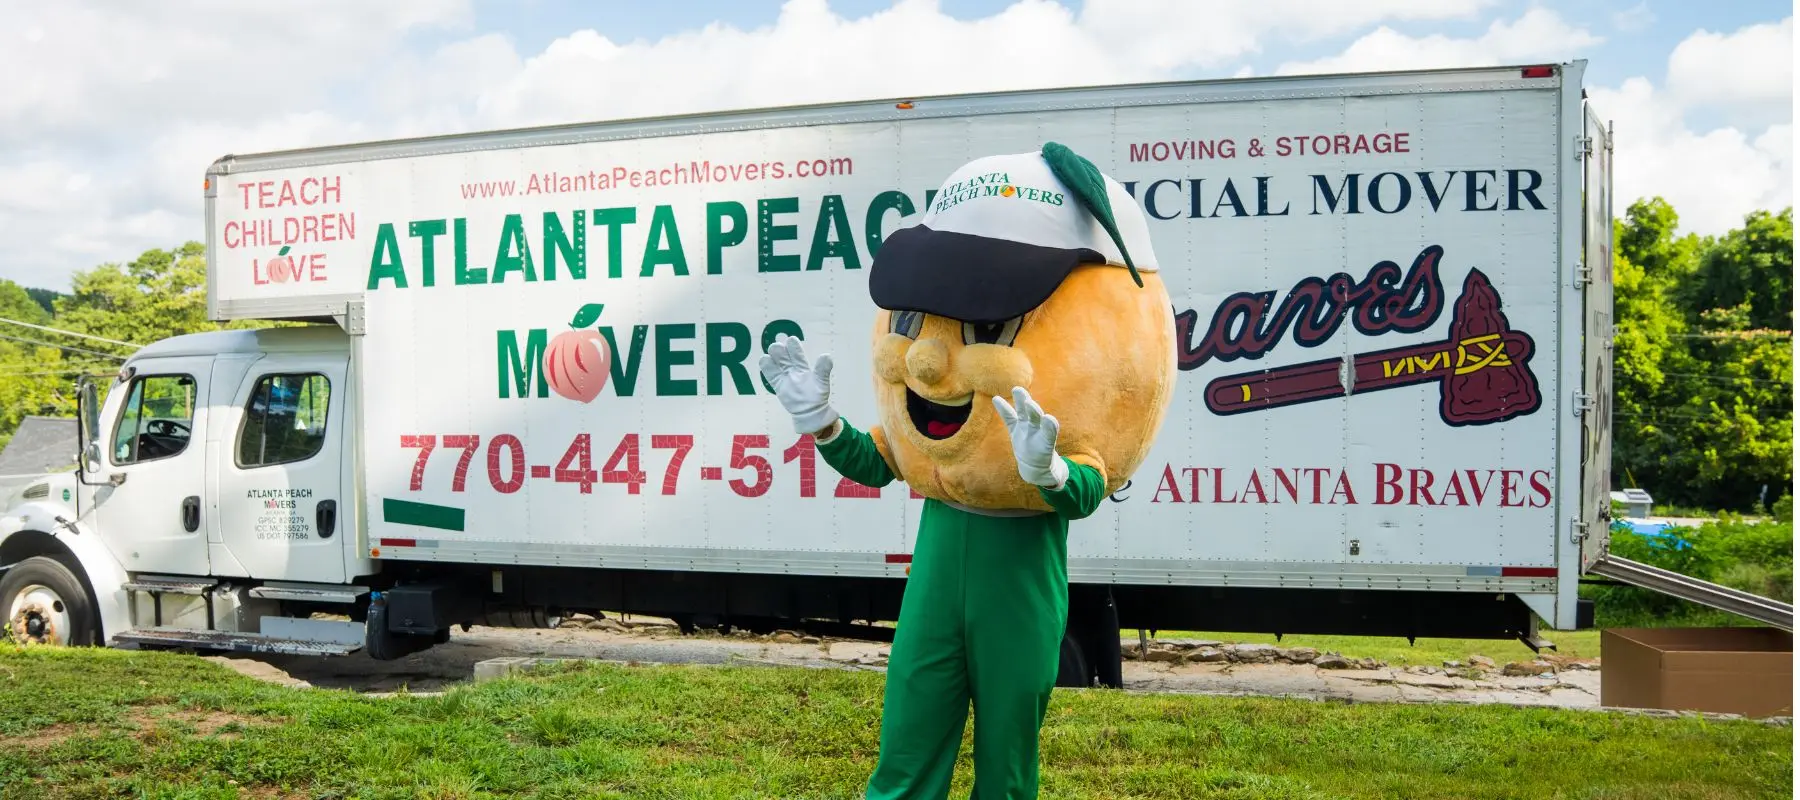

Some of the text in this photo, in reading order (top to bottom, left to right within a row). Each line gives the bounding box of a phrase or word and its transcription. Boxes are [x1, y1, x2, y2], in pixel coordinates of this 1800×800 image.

[1129, 132, 1411, 163] MOVING & STORAGE
[238, 176, 341, 210] TEACH
[461, 156, 853, 200] www.AtlantaPeachMovers.com
[941, 172, 1011, 199] ATLANTA
[1308, 168, 1549, 216] MOVER
[935, 187, 980, 214] PEACH
[224, 212, 356, 249] CHILDREN
[367, 190, 938, 290] ATLANTA PEAC
[400, 433, 926, 500] 770-447-51
[1151, 461, 1359, 505] ATLANTA
[1372, 461, 1552, 508] BRAVES
[247, 488, 313, 498] ATLANTA PEACH
